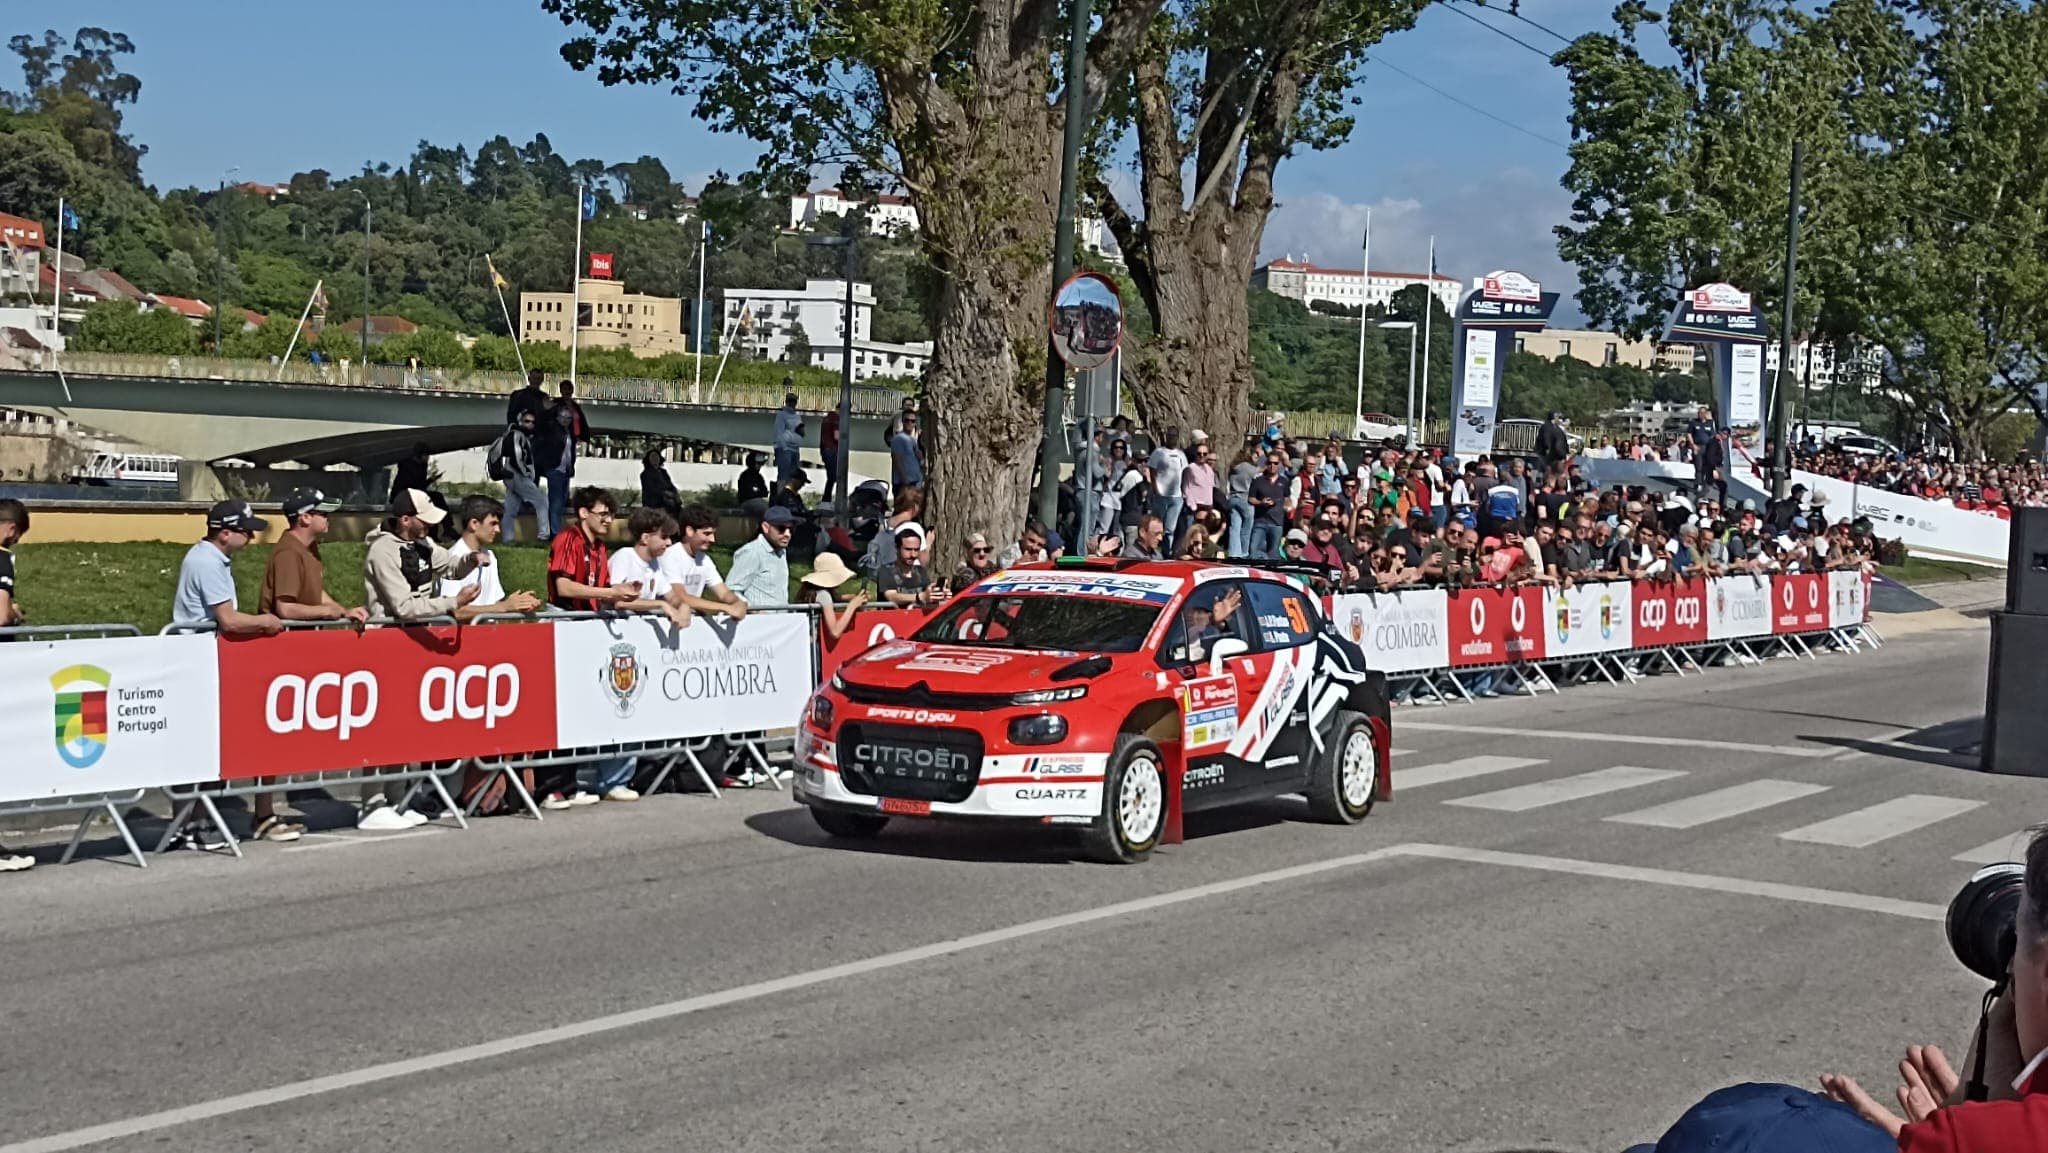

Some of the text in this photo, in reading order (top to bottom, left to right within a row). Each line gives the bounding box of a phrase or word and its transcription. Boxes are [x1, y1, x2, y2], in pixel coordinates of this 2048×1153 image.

[592, 259, 609, 269] ibis
[1282, 597, 1310, 634] 51
[1640, 600, 1666, 631] acp
[1675, 597, 1699, 629] acp
[1375, 622, 1438, 651] COIMBRA
[717, 646, 775, 663] MUNICIPAL
[1460, 639, 1492, 656] vodafone
[661, 663, 777, 701] COIMBRA
[117, 686, 164, 700] Turismo
[419, 663, 520, 729] acp
[117, 704, 157, 717] Centro
[265, 670, 379, 741] acp
[117, 716, 168, 734] Portugal
[1040, 764, 1084, 774] GLASS
[1015, 789, 1087, 800] QUARTZ
